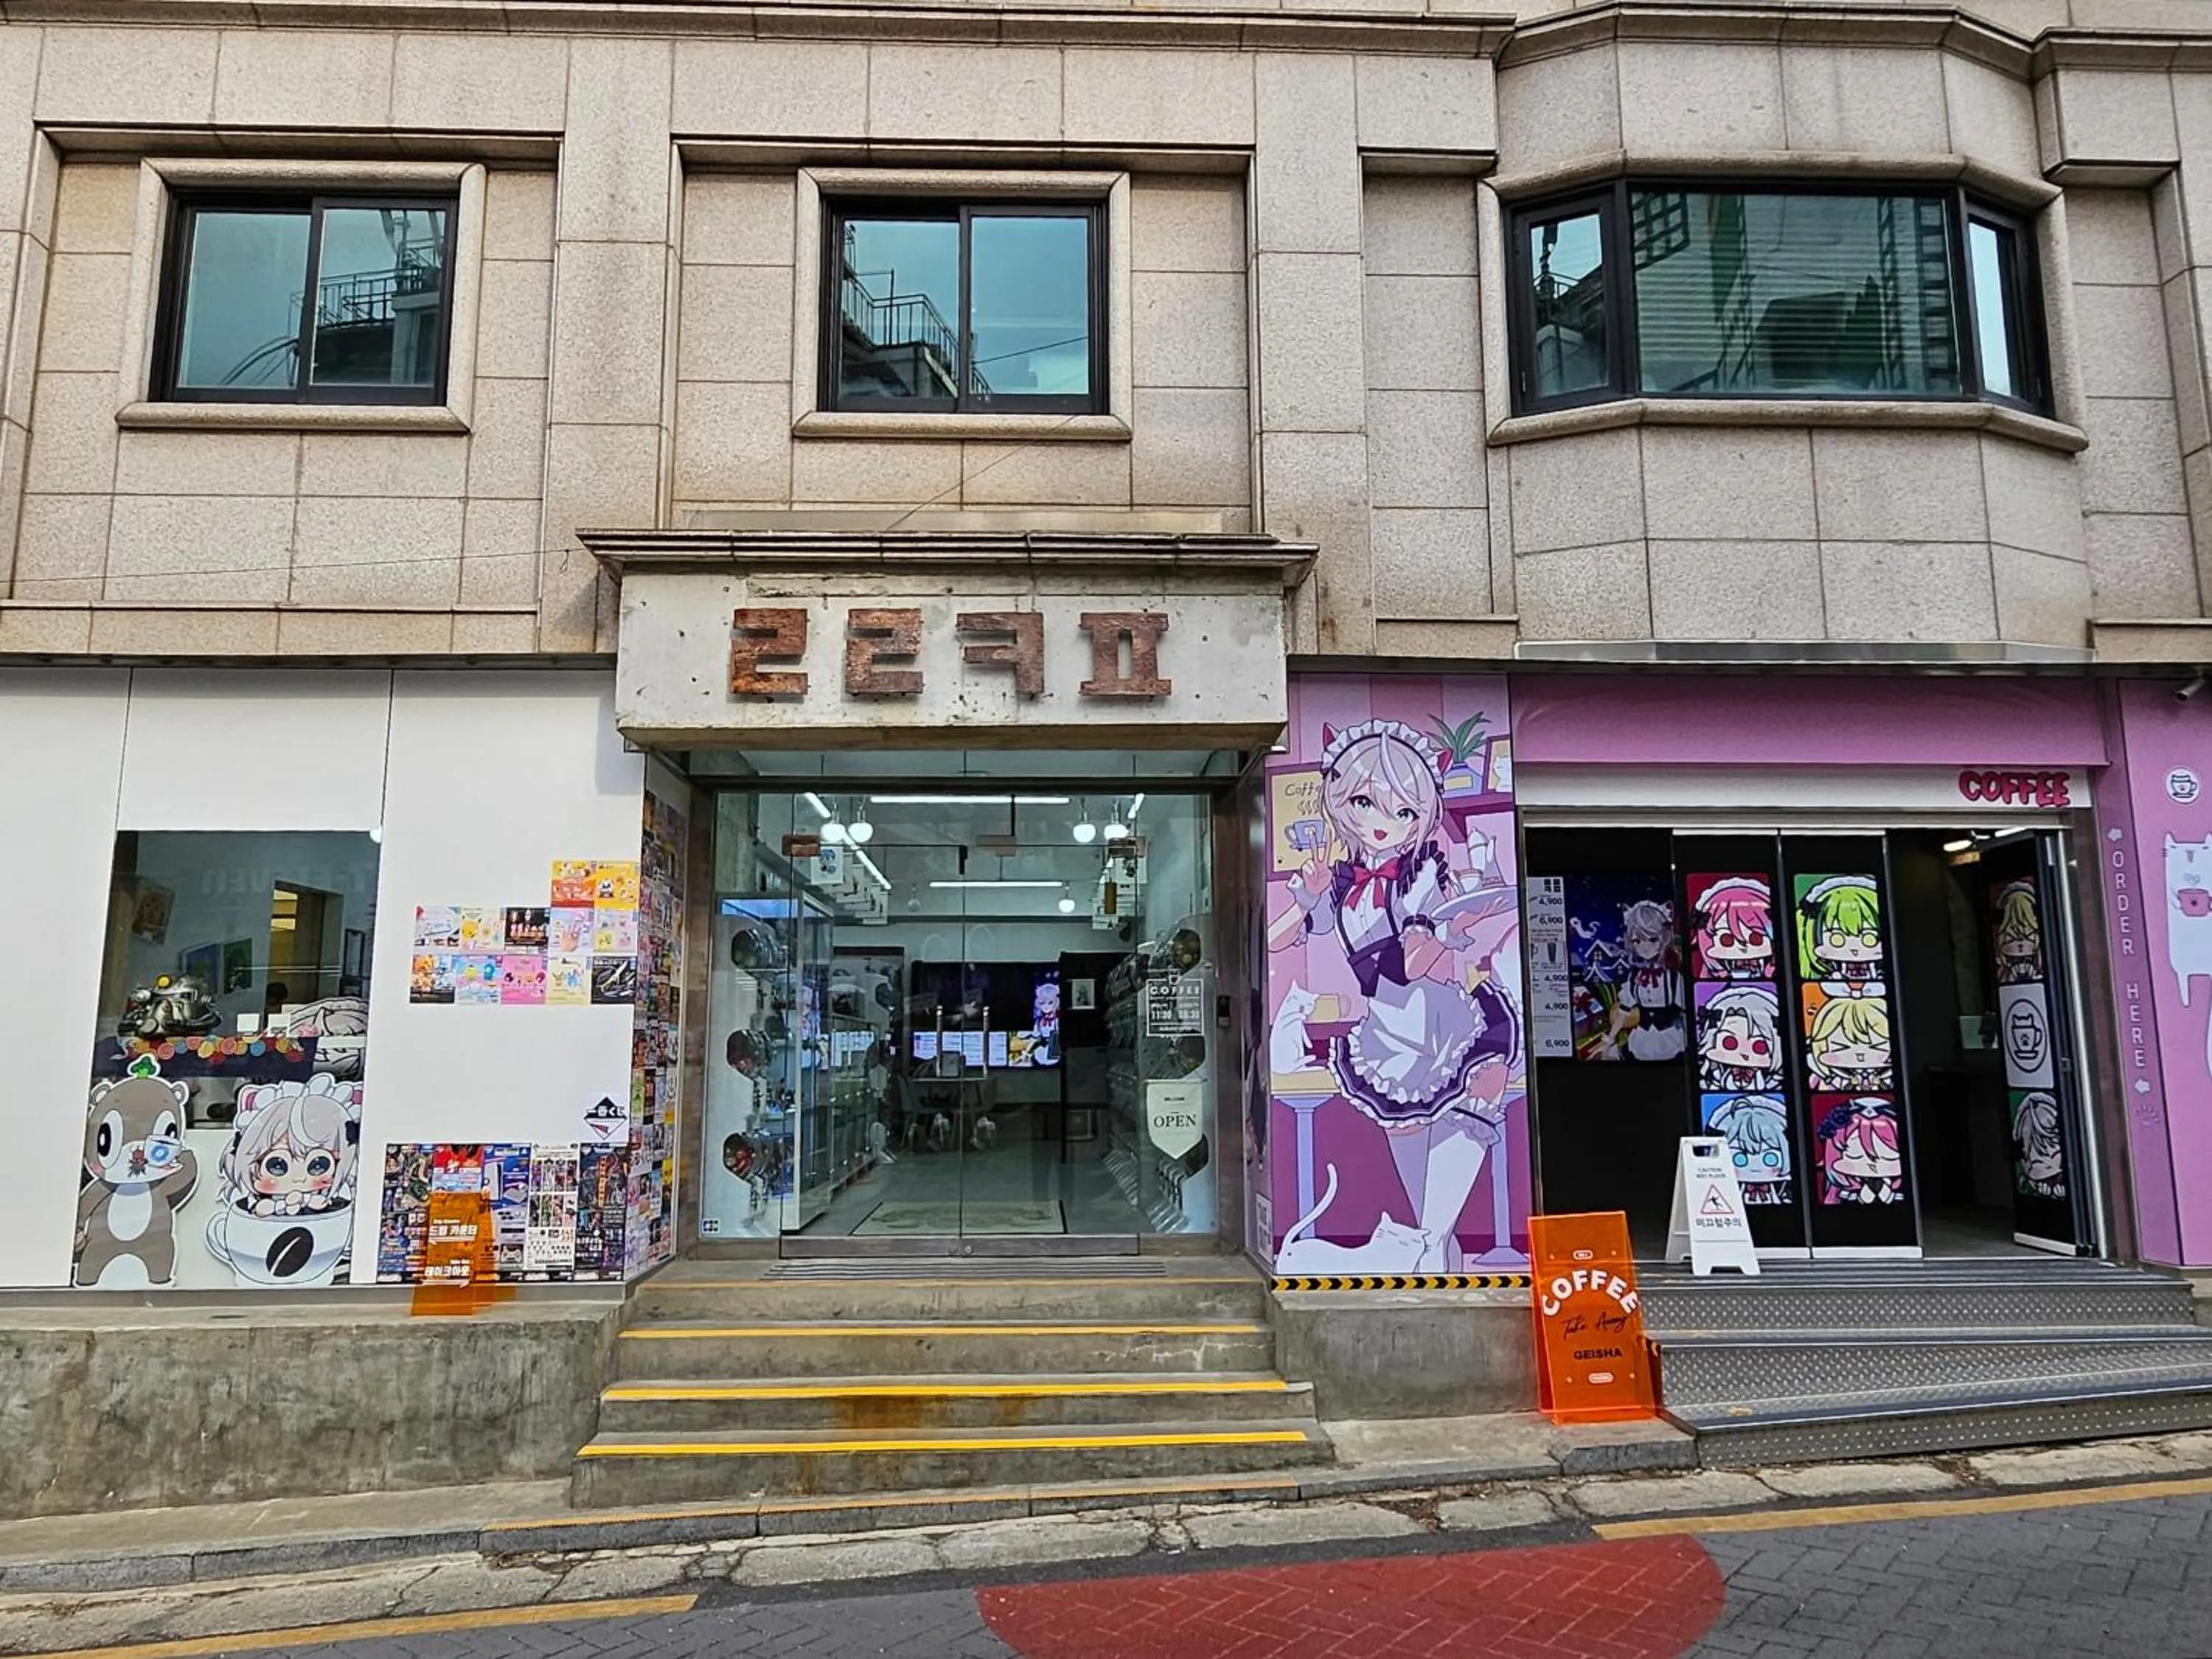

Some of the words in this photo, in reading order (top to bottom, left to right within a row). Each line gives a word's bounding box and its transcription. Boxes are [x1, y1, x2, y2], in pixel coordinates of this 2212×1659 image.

[1958, 771, 2070, 807] COFFEE
[2112, 850, 2135, 955] ORDER
[2126, 983, 2146, 1068] HERE
[1150, 986, 1200, 995] COFFEE
[1154, 1115, 1197, 1127] OPEN
[1542, 1270, 1640, 1315] COFFEE
[1573, 1348, 1622, 1360] GEISHA
